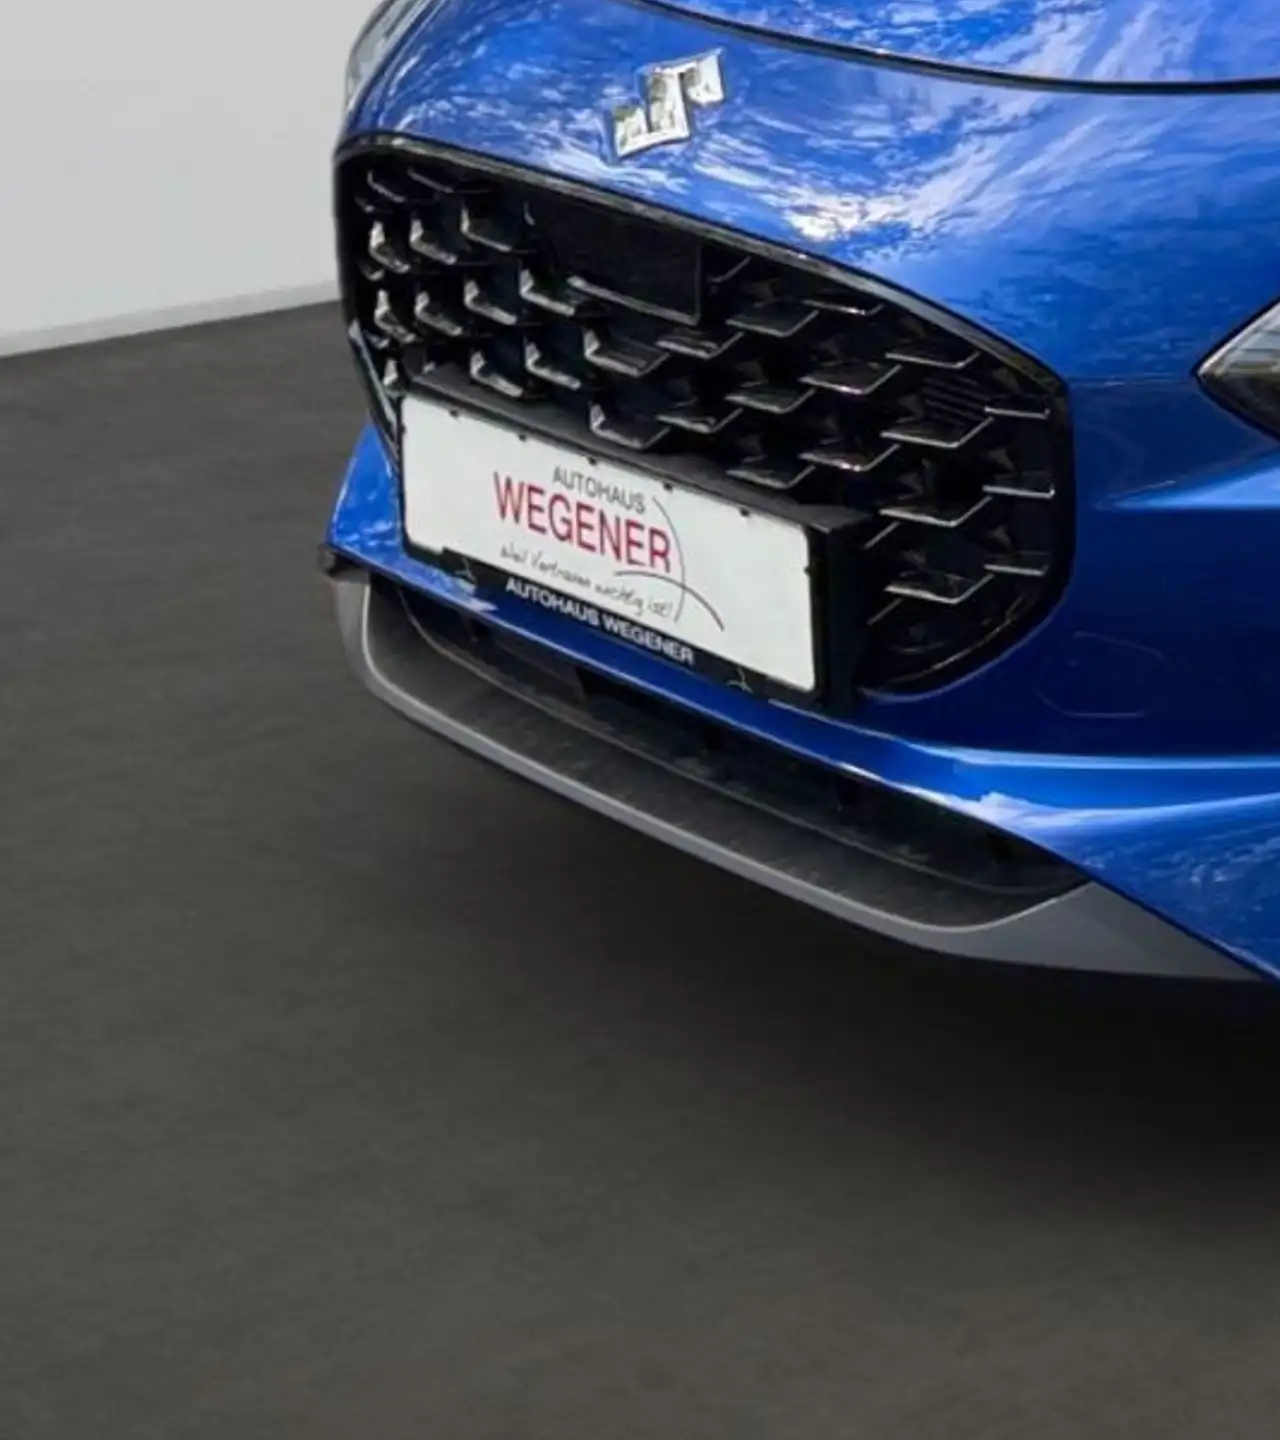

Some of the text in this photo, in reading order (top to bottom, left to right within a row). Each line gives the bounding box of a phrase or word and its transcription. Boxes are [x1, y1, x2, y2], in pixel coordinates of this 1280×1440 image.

[493, 471, 673, 574] WEGENER
[552, 465, 647, 515] AUTOHAUS
[505, 577, 695, 667] AUTOHAUS WEGENER
